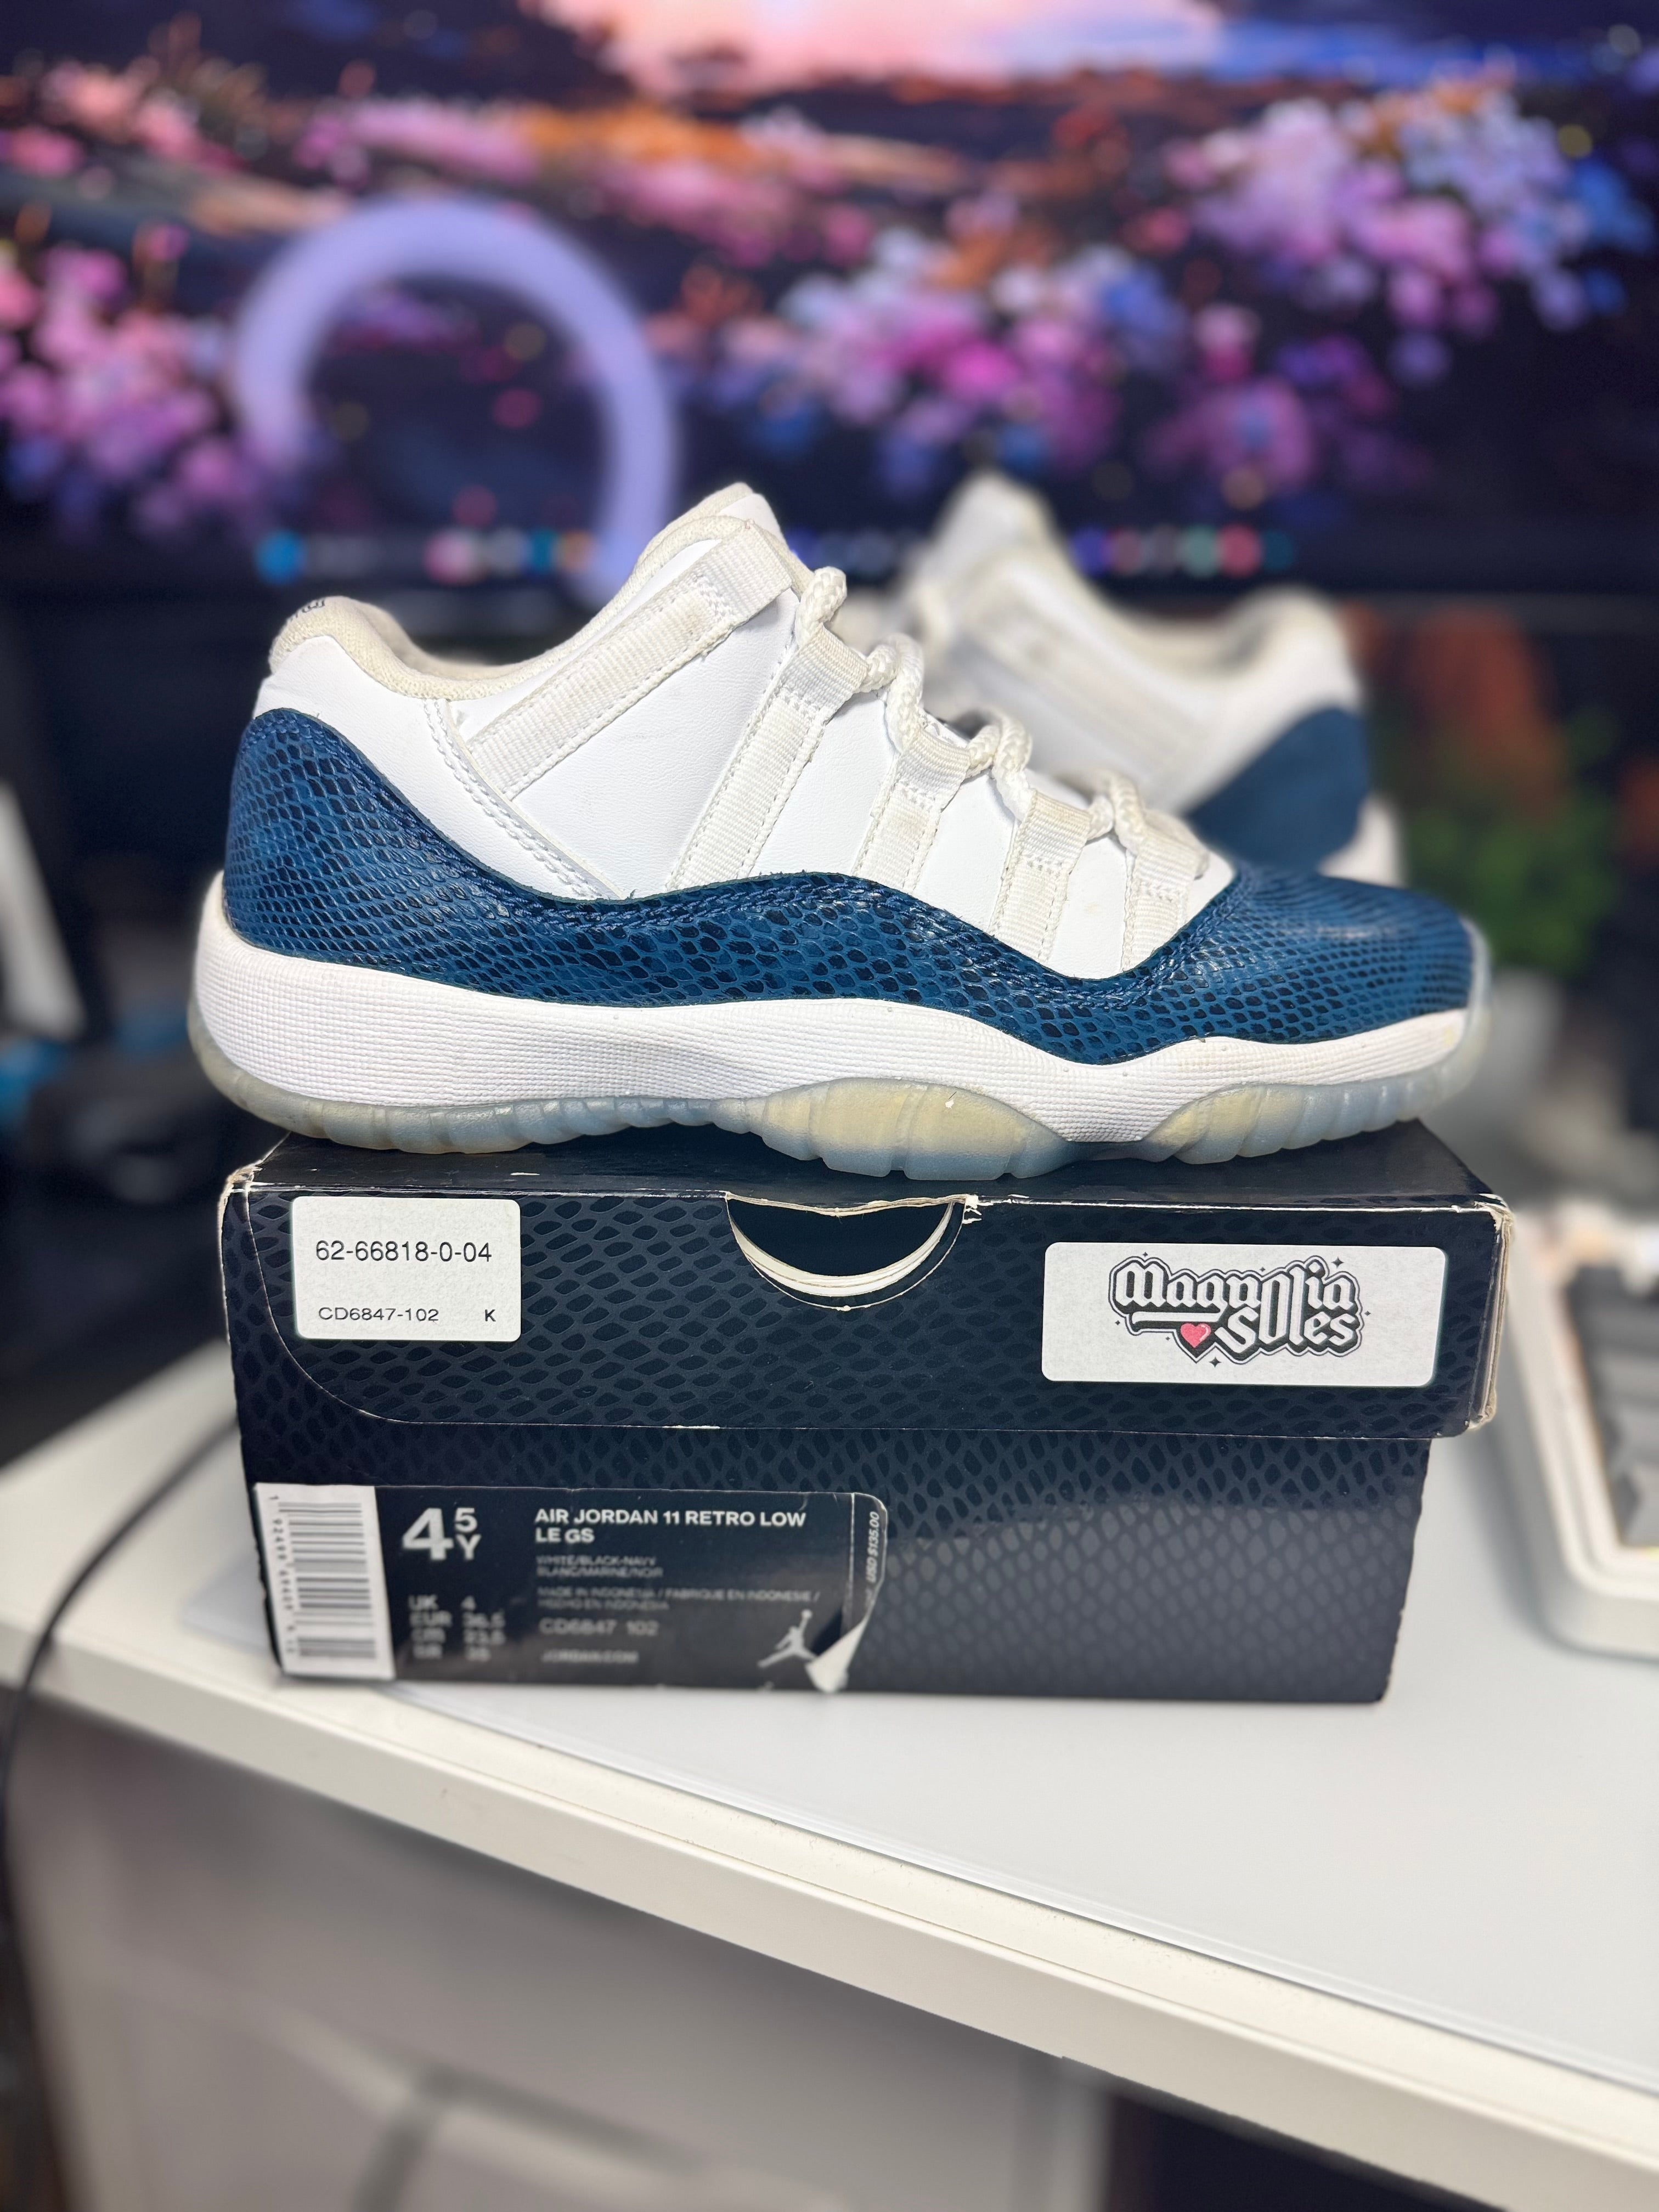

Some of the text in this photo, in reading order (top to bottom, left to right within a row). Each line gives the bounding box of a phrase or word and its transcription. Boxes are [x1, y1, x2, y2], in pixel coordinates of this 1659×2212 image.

[316, 1240, 492, 1262] 62-66818-0-04
[318, 1307, 496, 1322] CD6847-102 K
[534, 1508, 806, 1527] AIR JORDAN 11 RETRO LOW
[402, 1508, 477, 1561] 4 5
[535, 1527, 595, 1544] LE GS
[867, 1511, 879, 1556] $135.00
[455, 1534, 481, 1560] Y
[866, 1556, 877, 1583] USD
